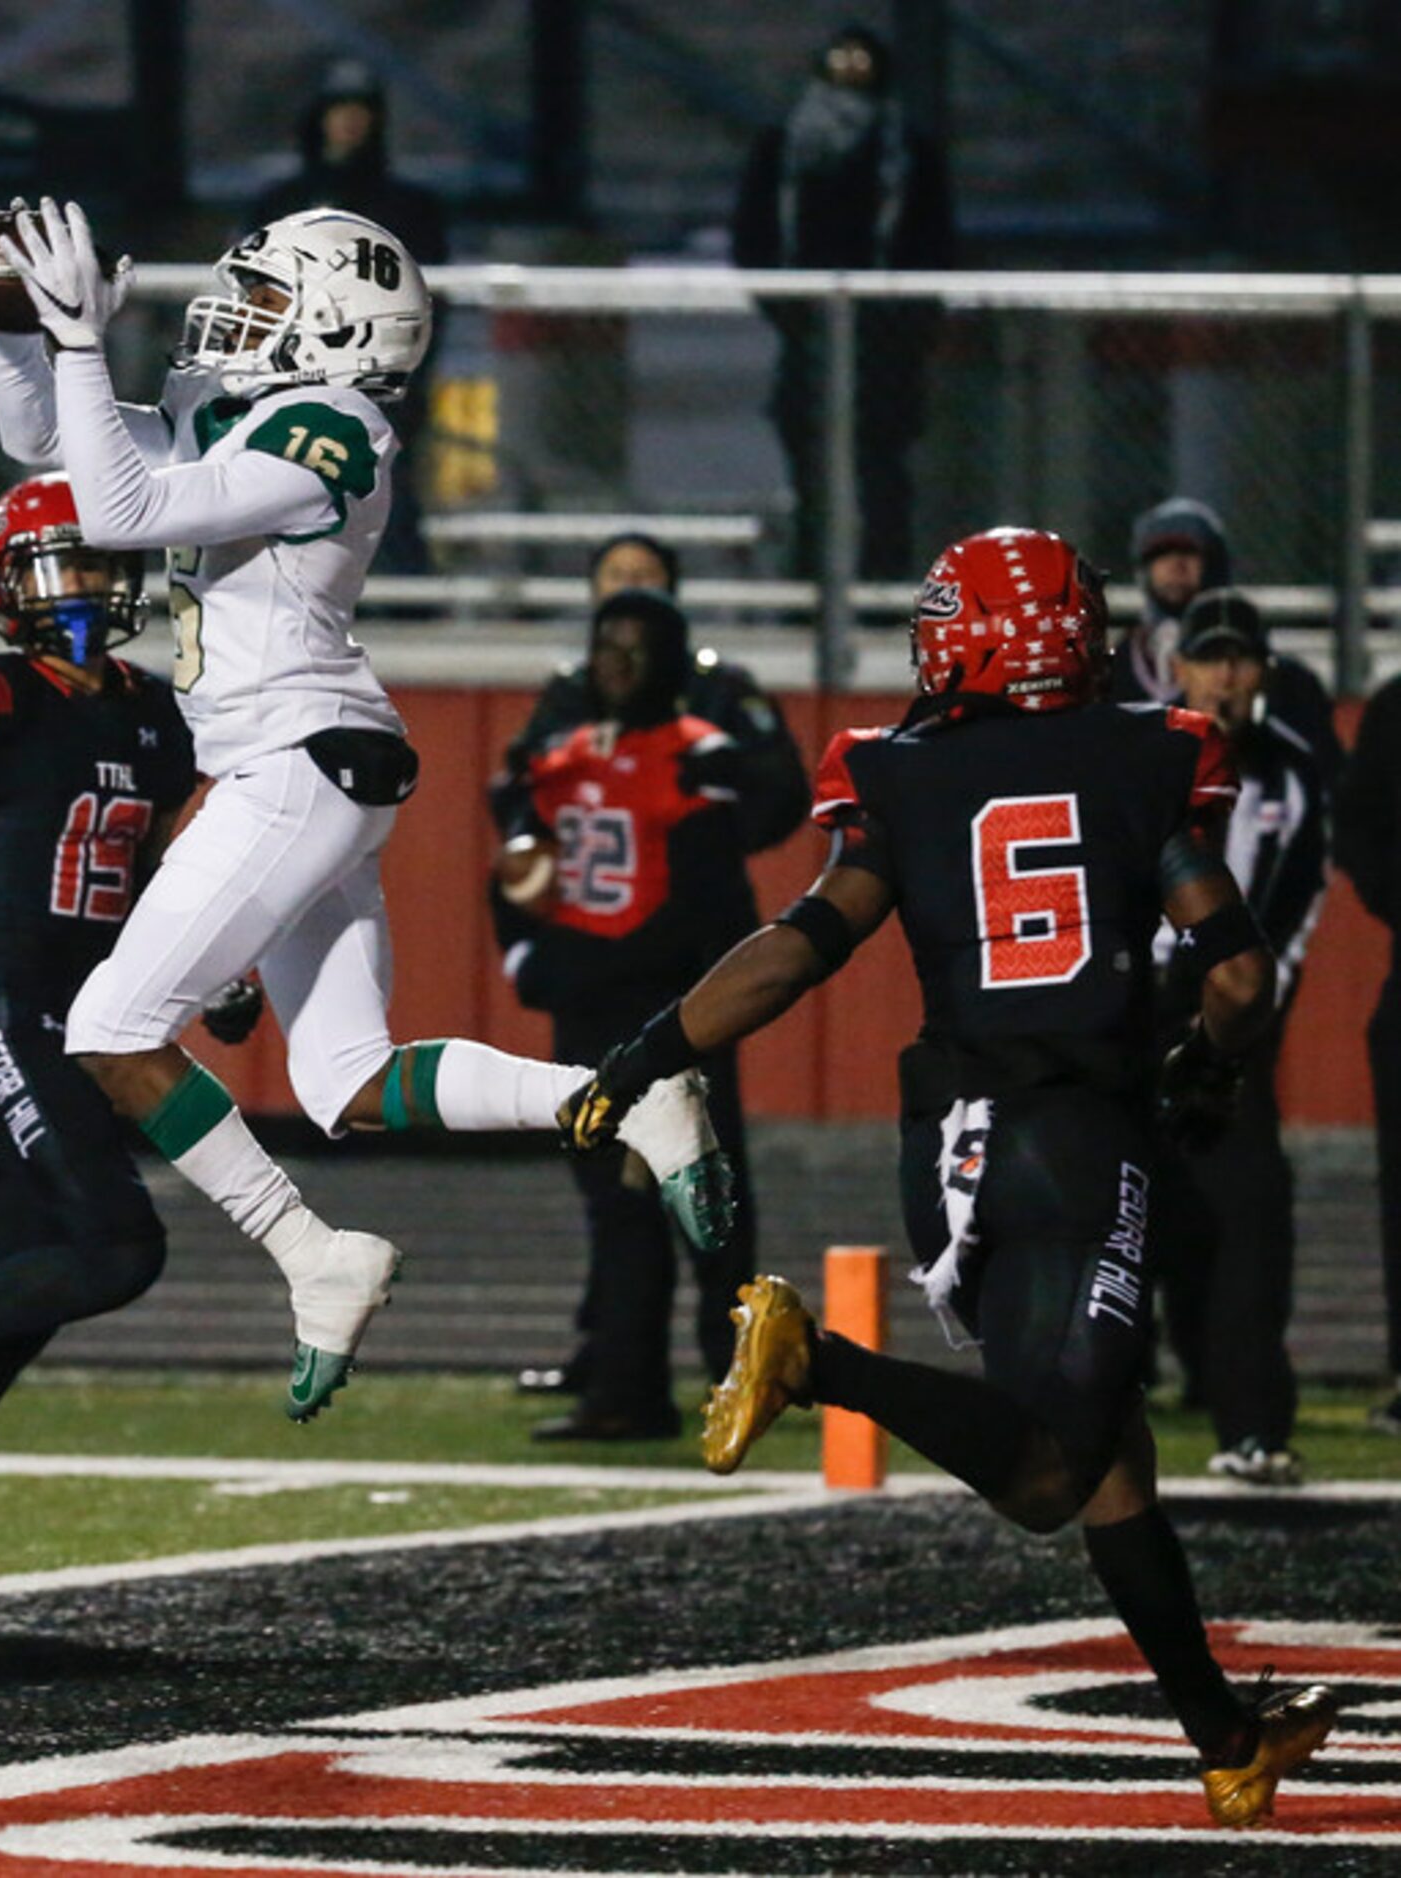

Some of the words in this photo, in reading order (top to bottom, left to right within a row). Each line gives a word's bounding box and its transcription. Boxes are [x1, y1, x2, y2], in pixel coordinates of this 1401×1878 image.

[353, 236, 401, 292] 16
[970, 792, 1092, 990] 6
[3, 1095, 47, 1160] HILL
[1103, 1160, 1150, 1264] CEDAR
[1086, 1258, 1141, 1328] HILL
